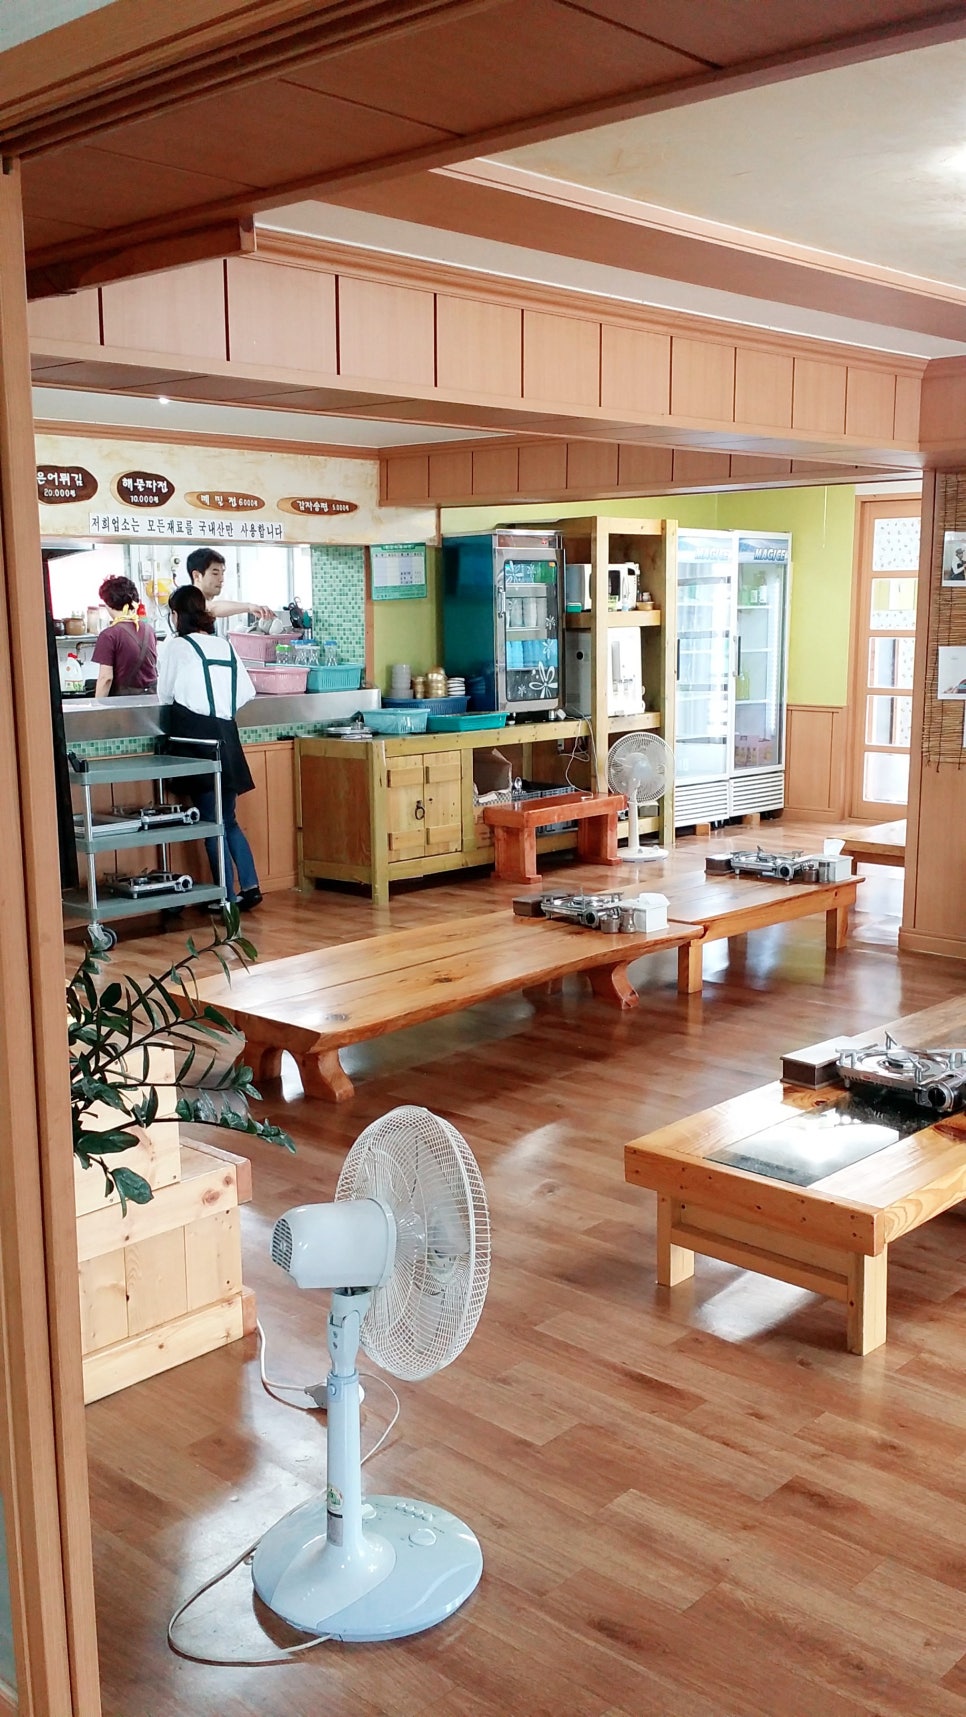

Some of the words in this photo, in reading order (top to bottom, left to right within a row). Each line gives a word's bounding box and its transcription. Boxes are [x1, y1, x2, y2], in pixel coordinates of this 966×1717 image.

[36, 471, 83, 487] 은어튀김
[122, 477, 169, 493] 해물파전
[91, 516, 140, 533] 저희업소는
[147, 519, 194, 536] 모든재료를
[198, 520, 234, 538] 국내산만
[240, 523, 283, 539] 사용합니다
